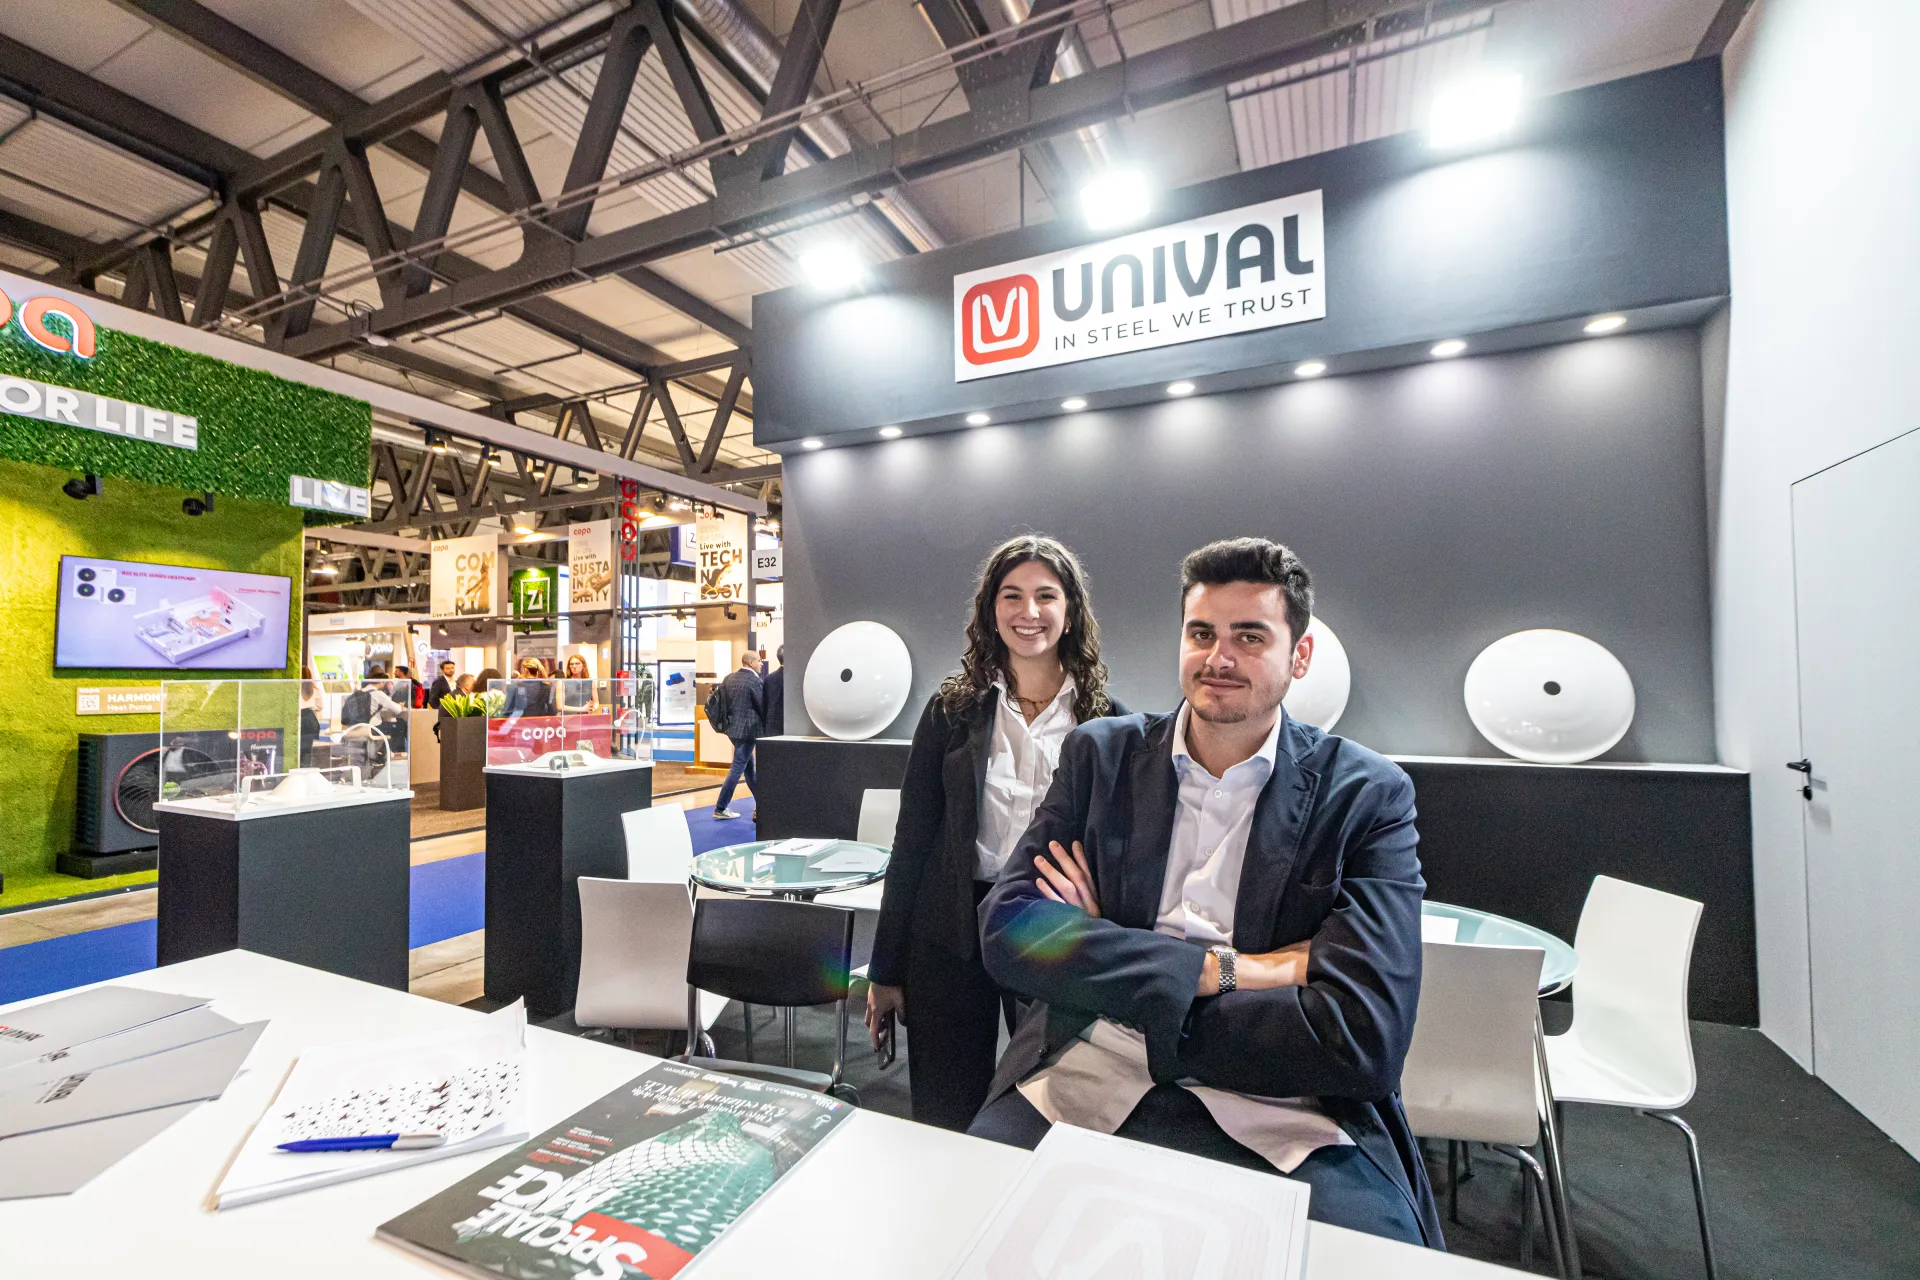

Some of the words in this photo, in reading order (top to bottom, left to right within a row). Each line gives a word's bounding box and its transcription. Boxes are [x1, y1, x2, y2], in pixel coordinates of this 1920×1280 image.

[1053, 214, 1314, 322] UNIVAL
[0, 287, 96, 358] a
[1055, 334, 1075, 350] IN
[1087, 318, 1159, 344] STEEL
[1172, 307, 1211, 328] WE
[1224, 288, 1312, 319] TRUST
[95, 398, 197, 447] LIFE
[715, 540, 731, 549] with
[455, 551, 495, 573] COM
[572, 560, 610, 577] SUSTA
[700, 548, 743, 567] TECH
[757, 556, 777, 569] E32
[128, 703, 153, 711] Pump
[521, 726, 567, 743] copa
[477, 1164, 621, 1221] MCE
[466, 1202, 648, 1280] SPECIALE
